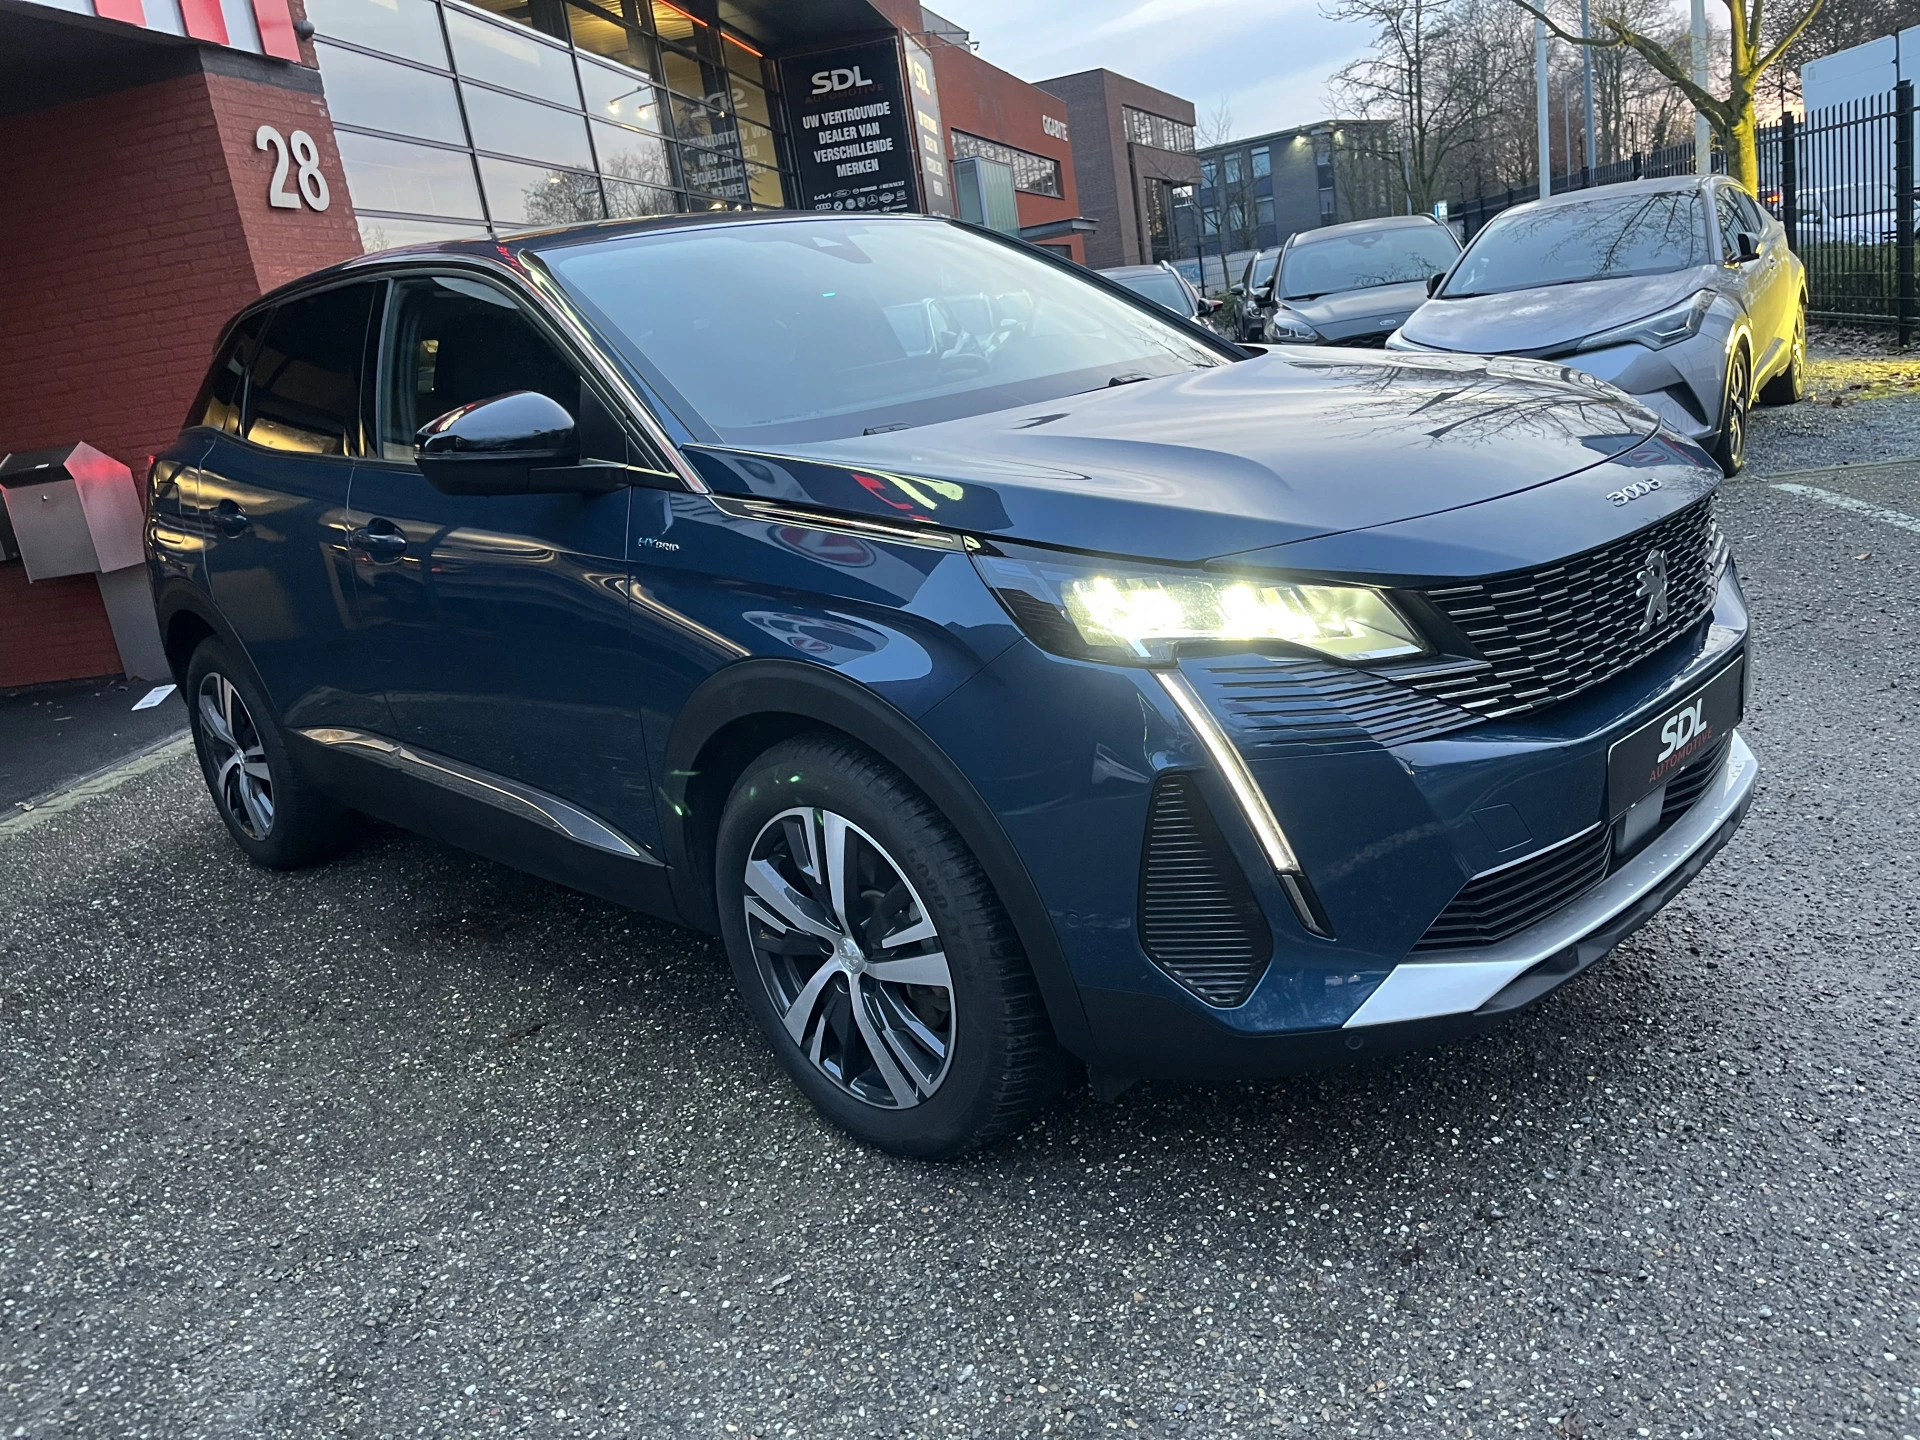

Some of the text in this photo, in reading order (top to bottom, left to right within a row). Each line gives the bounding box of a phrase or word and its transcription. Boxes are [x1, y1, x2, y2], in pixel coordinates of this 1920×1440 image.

[804, 83, 884, 104] AUTOMOTIVE
[811, 66, 873, 95] SDL
[802, 102, 891, 129] UW VERTROUWDE
[818, 122, 881, 144] DEALER VAN
[813, 137, 894, 163] VERSCHILLENDE
[256, 125, 330, 212] 28
[836, 158, 880, 178] MERKEN
[1606, 478, 1662, 508] 3008
[1657, 698, 1707, 763] SDL
[1648, 725, 1713, 784] AUTOMOTIVE
